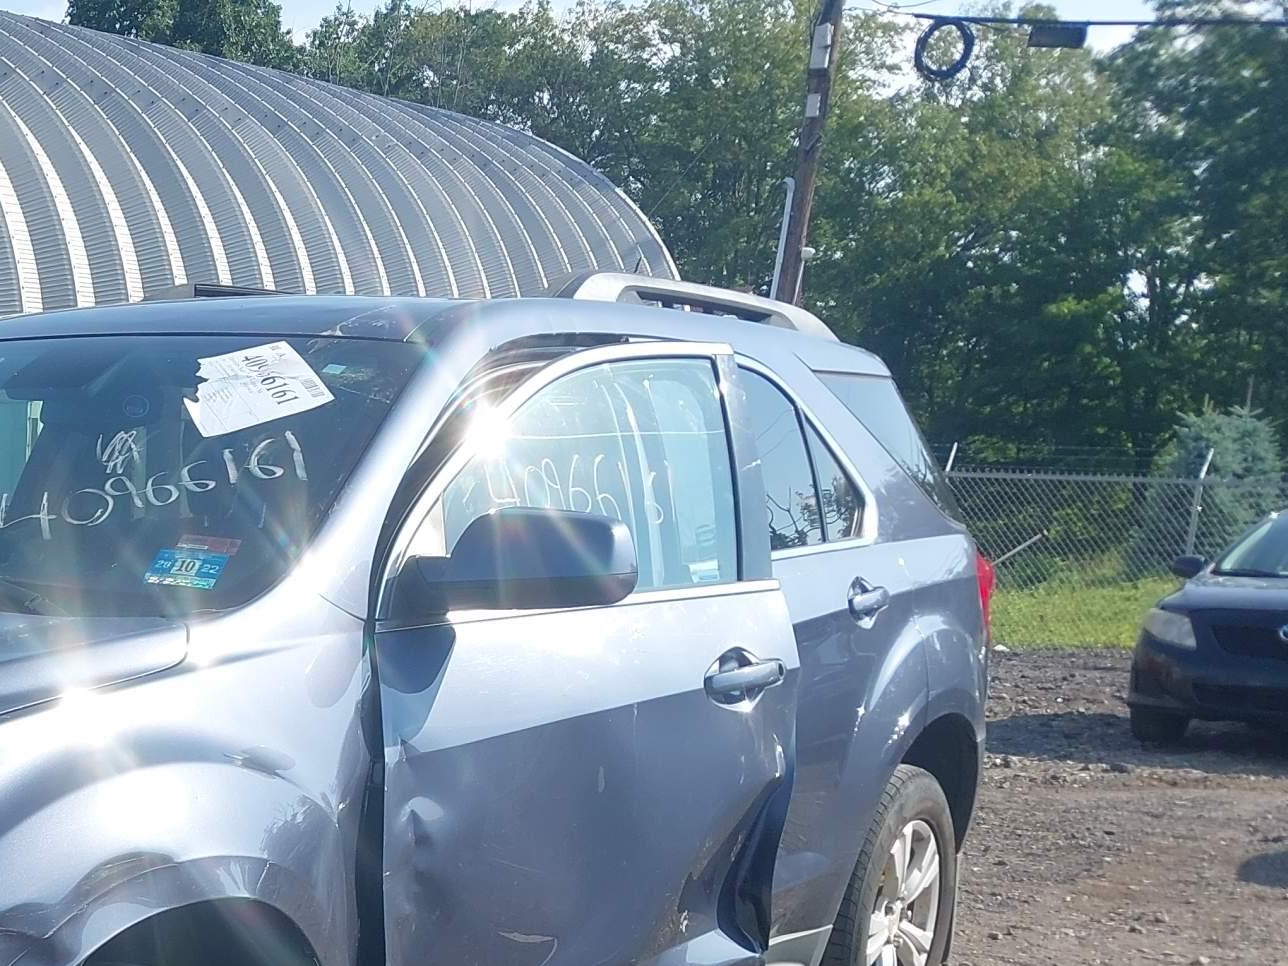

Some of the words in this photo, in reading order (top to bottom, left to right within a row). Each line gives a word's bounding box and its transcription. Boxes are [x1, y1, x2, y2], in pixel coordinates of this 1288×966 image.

[155, 559, 172, 569] 20
[175, 559, 197, 573] 10
[200, 563, 220, 574] 22
